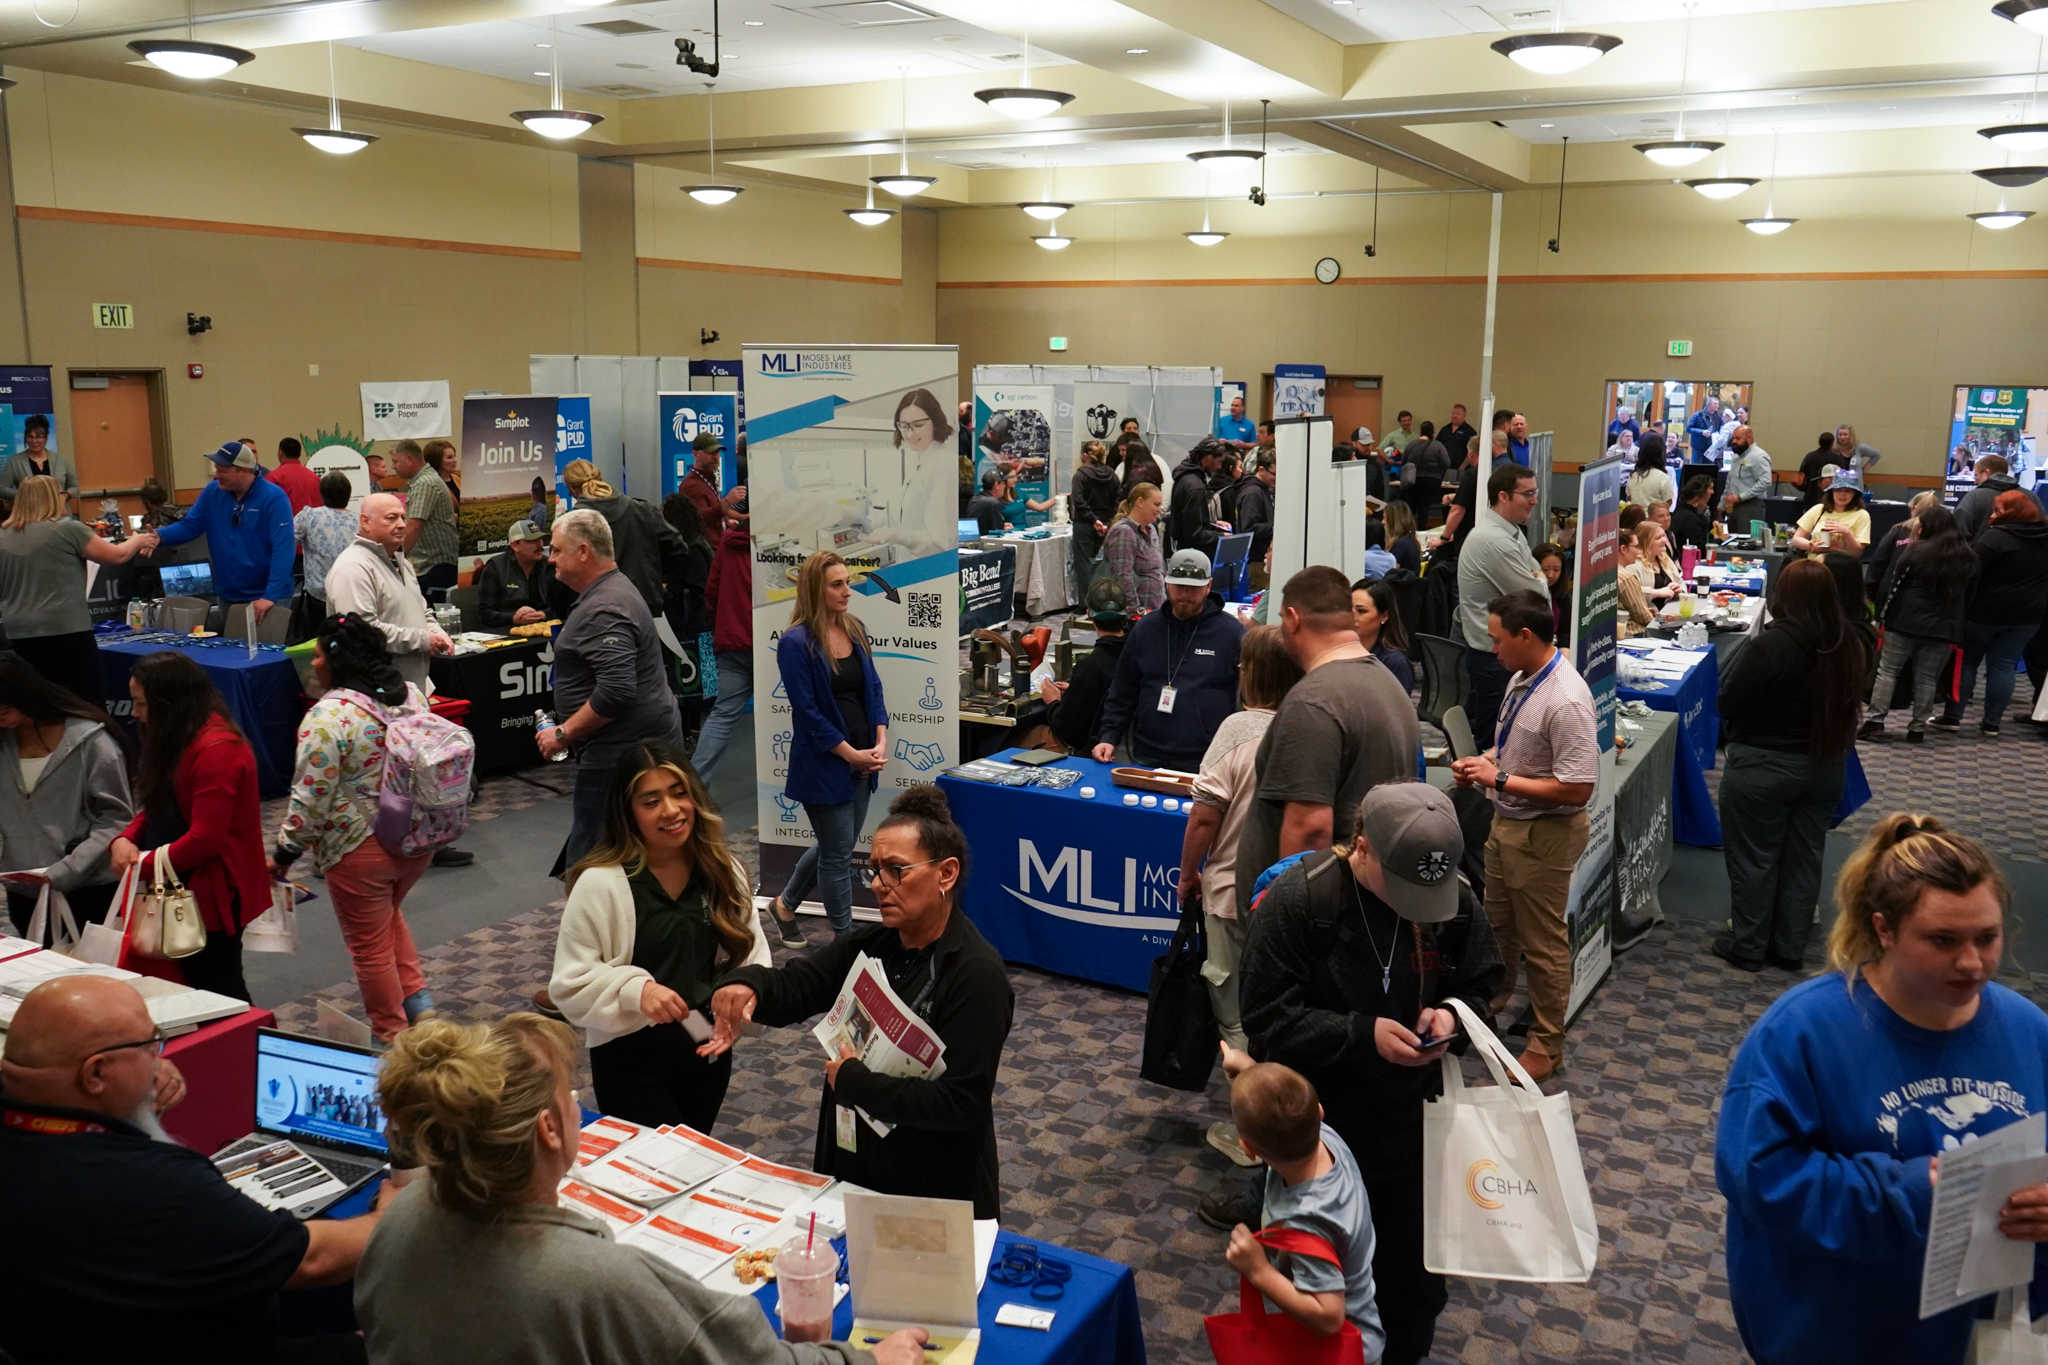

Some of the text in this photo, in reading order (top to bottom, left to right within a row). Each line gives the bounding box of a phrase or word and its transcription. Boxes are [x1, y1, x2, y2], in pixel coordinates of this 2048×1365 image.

[100, 305, 127, 327] EXIT
[1672, 341, 1688, 355] EXIT
[762, 353, 852, 372] MLI MOSES LAKE
[802, 362, 853, 370] INDUSTRIES
[397, 401, 438, 410] International
[1281, 402, 1316, 414] TEAM
[398, 411, 418, 419] Paper
[699, 413, 723, 424] Grant
[495, 417, 530, 431] Simplot
[567, 419, 585, 431] Grant
[700, 425, 725, 437] PUD
[567, 431, 585, 446] PUD
[479, 440, 543, 467] Join Us
[757, 553, 881, 568] Looking fo career?
[961, 560, 1002, 588] Big Bend
[88, 605, 127, 615] ADVANCIN
[892, 637, 937, 650] Values
[771, 704, 793, 715] SAF
[501, 715, 534, 729] Bringing
[773, 768, 788, 778] CO
[895, 777, 935, 788] SERVIC
[775, 827, 817, 839] INTEGR
[1019, 838, 1182, 914] MLI MO
[1142, 934, 1149, 943] A
[865, 1033, 879, 1053] hiring
[1880, 1077, 2026, 1112] NO LONGER AT MY SIDE
[1482, 1175, 1538, 1195] CBHA
[1486, 1218, 1522, 1229] CBHA.org
